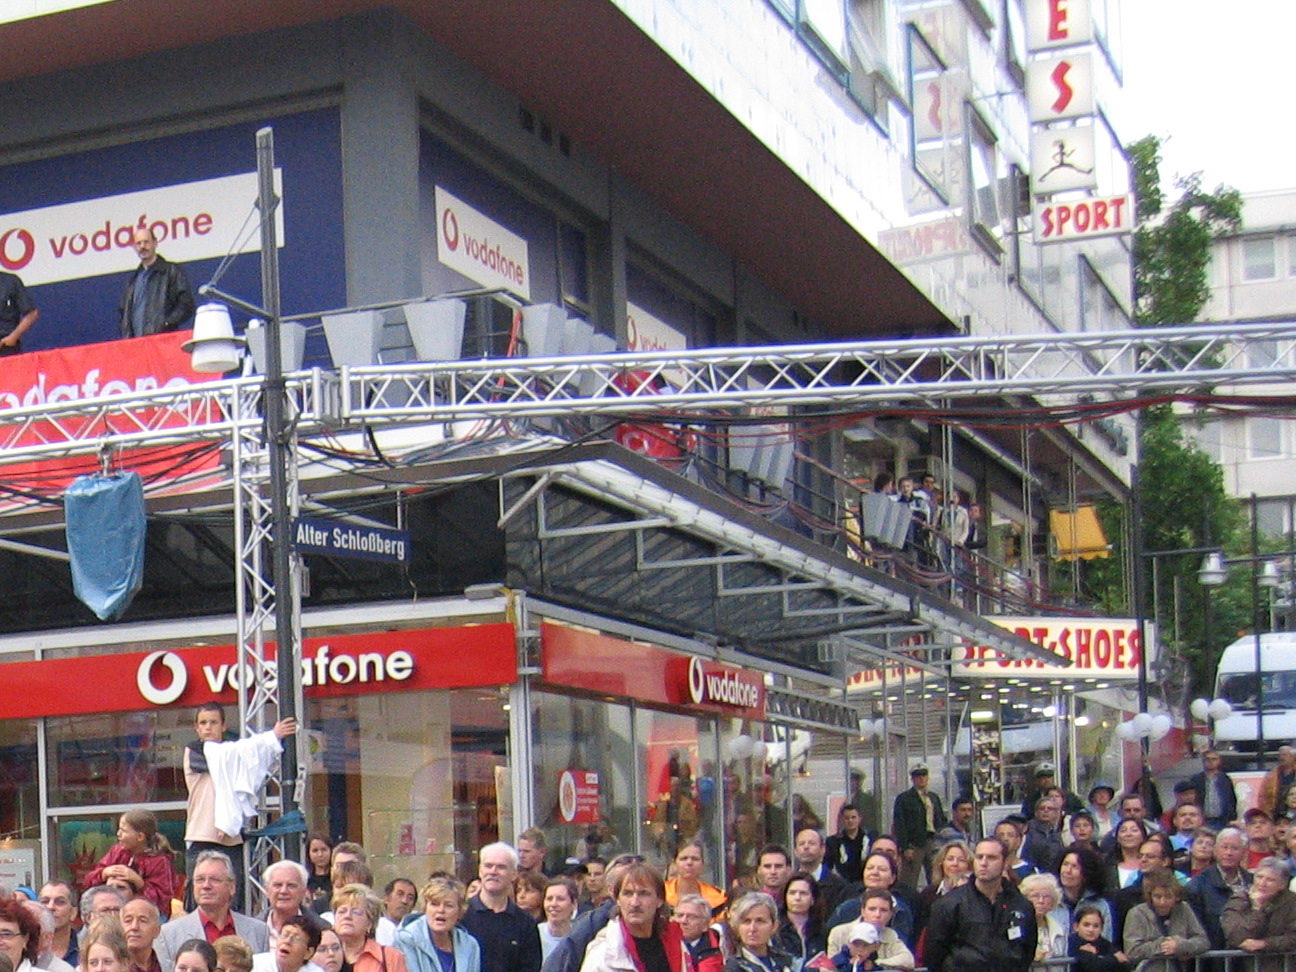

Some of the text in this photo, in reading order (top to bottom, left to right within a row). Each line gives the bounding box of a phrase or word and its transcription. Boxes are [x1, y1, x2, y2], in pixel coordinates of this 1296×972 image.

[49, 212, 214, 259] vodafone
[1041, 197, 1125, 238] SPORT
[463, 232, 524, 285] vodafone
[296, 523, 405, 560] Alter Schloßberg
[706, 670, 759, 708] vodafone
